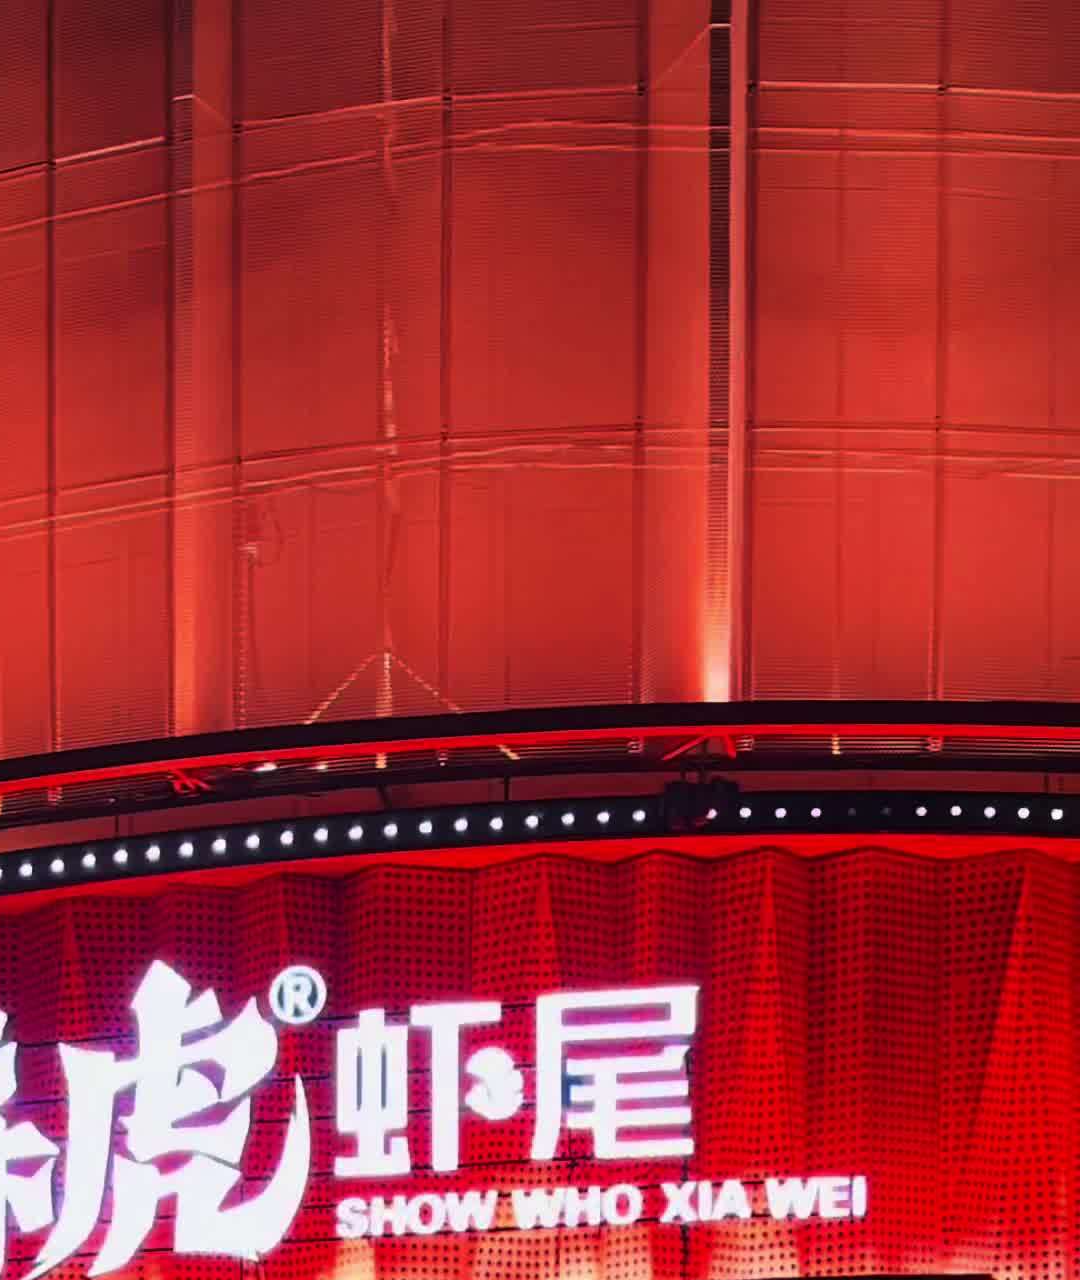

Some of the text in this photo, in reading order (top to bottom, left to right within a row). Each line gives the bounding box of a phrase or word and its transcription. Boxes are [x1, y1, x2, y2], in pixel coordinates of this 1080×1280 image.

[335, 1176, 868, 1240] SHOW WHO XIA WEI
